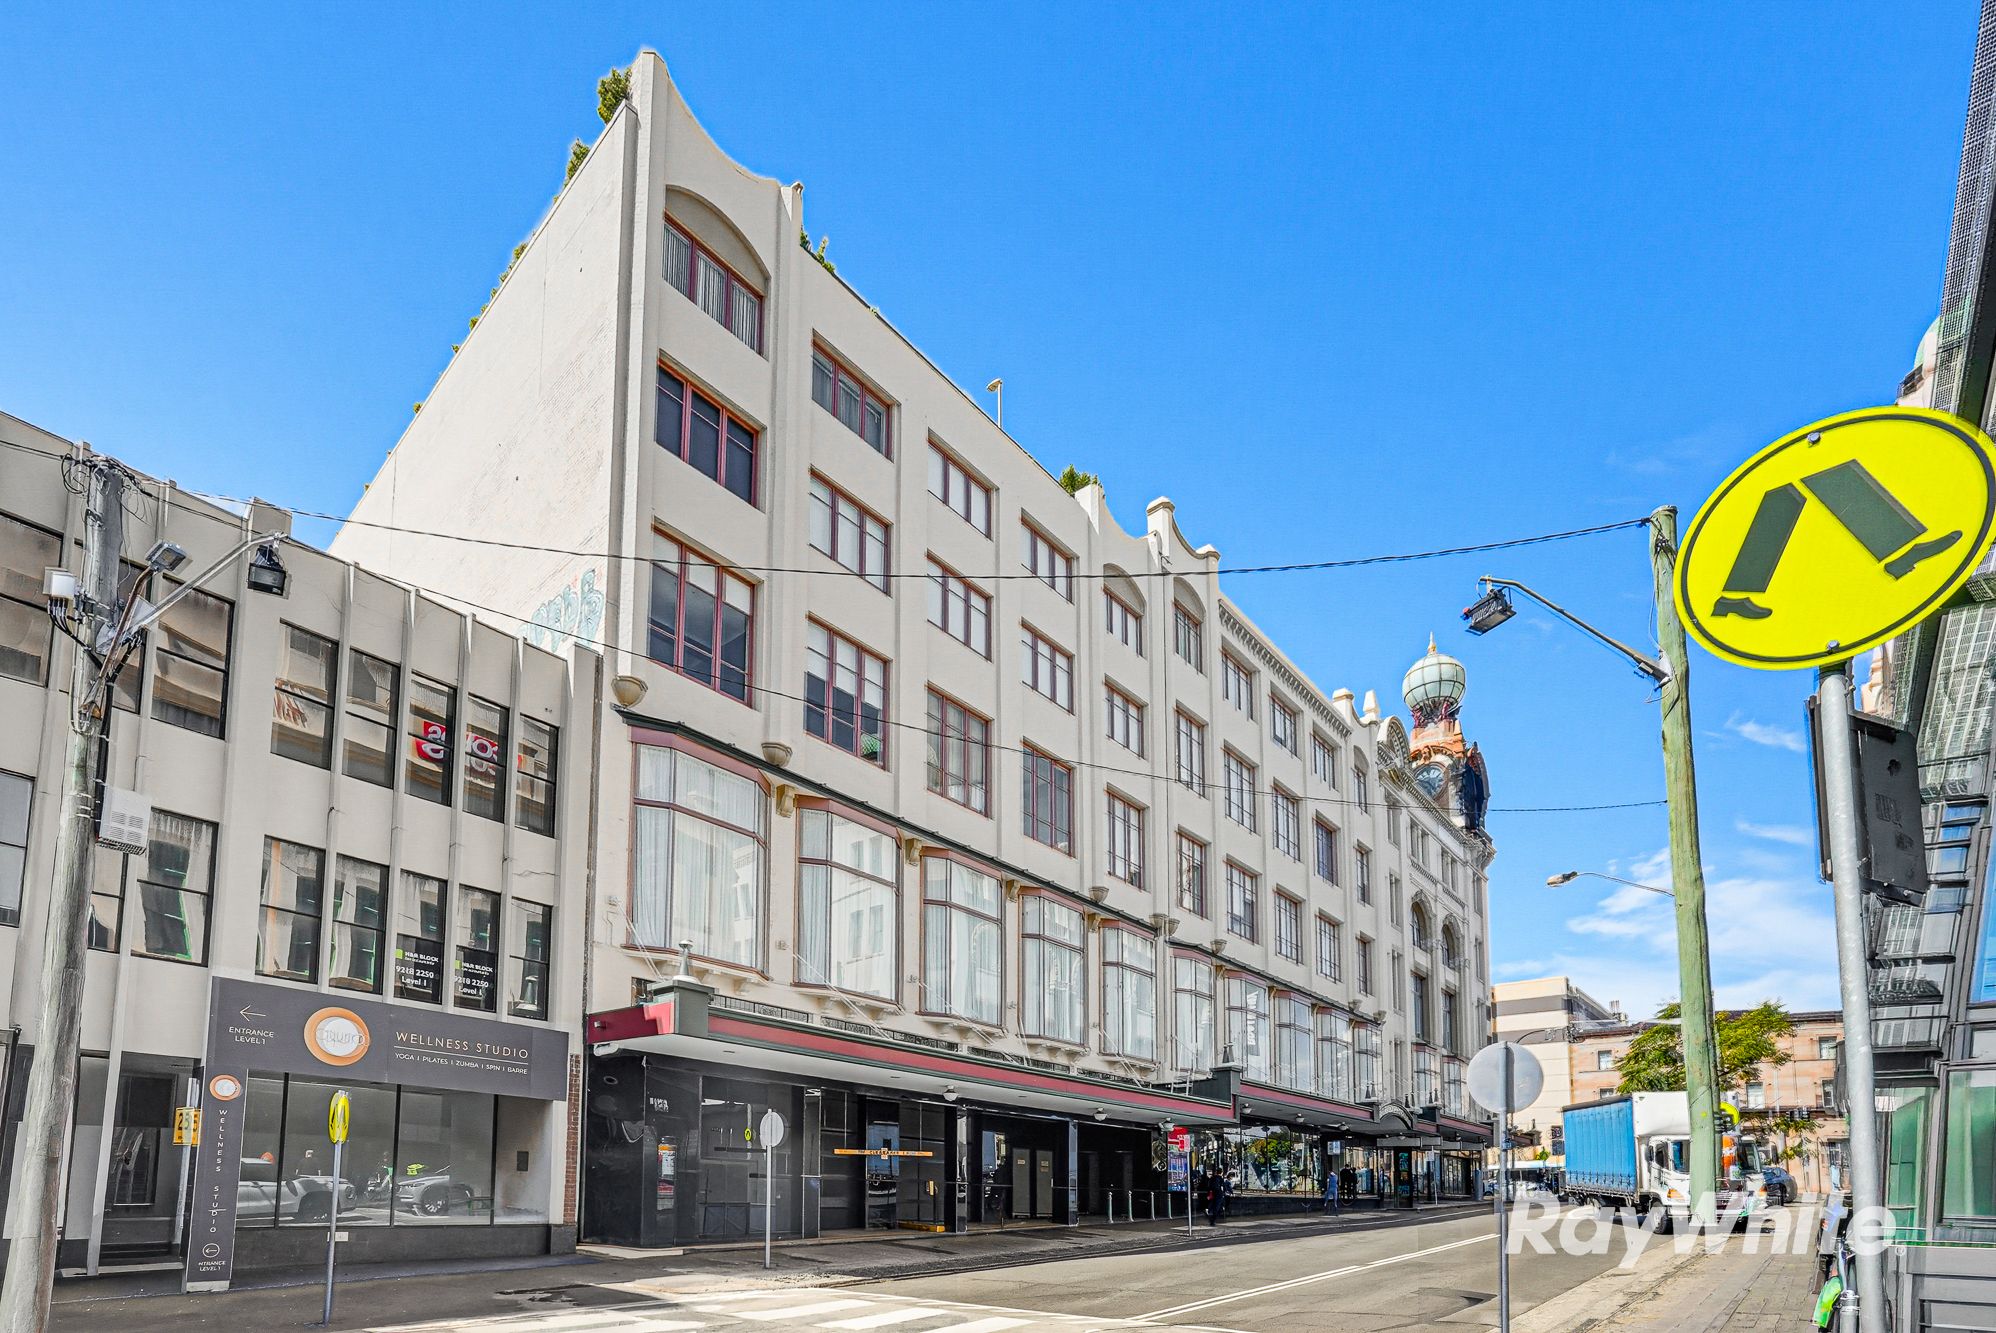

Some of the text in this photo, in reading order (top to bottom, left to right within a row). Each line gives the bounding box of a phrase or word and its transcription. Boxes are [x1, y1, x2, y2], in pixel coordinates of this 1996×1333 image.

[419, 954, 439, 962] BLOCK
[396, 965, 435, 979] 9218 2250
[475, 965, 494, 973] BLOCK
[402, 976, 421, 986] Level
[471, 979, 489, 988] 2250
[459, 986, 477, 995] Level
[228, 1026, 275, 1038] ENTRANCE
[235, 1035, 260, 1044] LEVEL
[395, 1031, 469, 1051] WELLNESS
[476, 1041, 529, 1059] STUDIO
[395, 1052, 415, 1060] YOGA
[422, 1055, 449, 1065] PILATES
[455, 1060, 479, 1069] ZUMBA
[507, 1066, 528, 1075] BARRE
[209, 1109, 228, 1233] WELLNESS STUDIO
